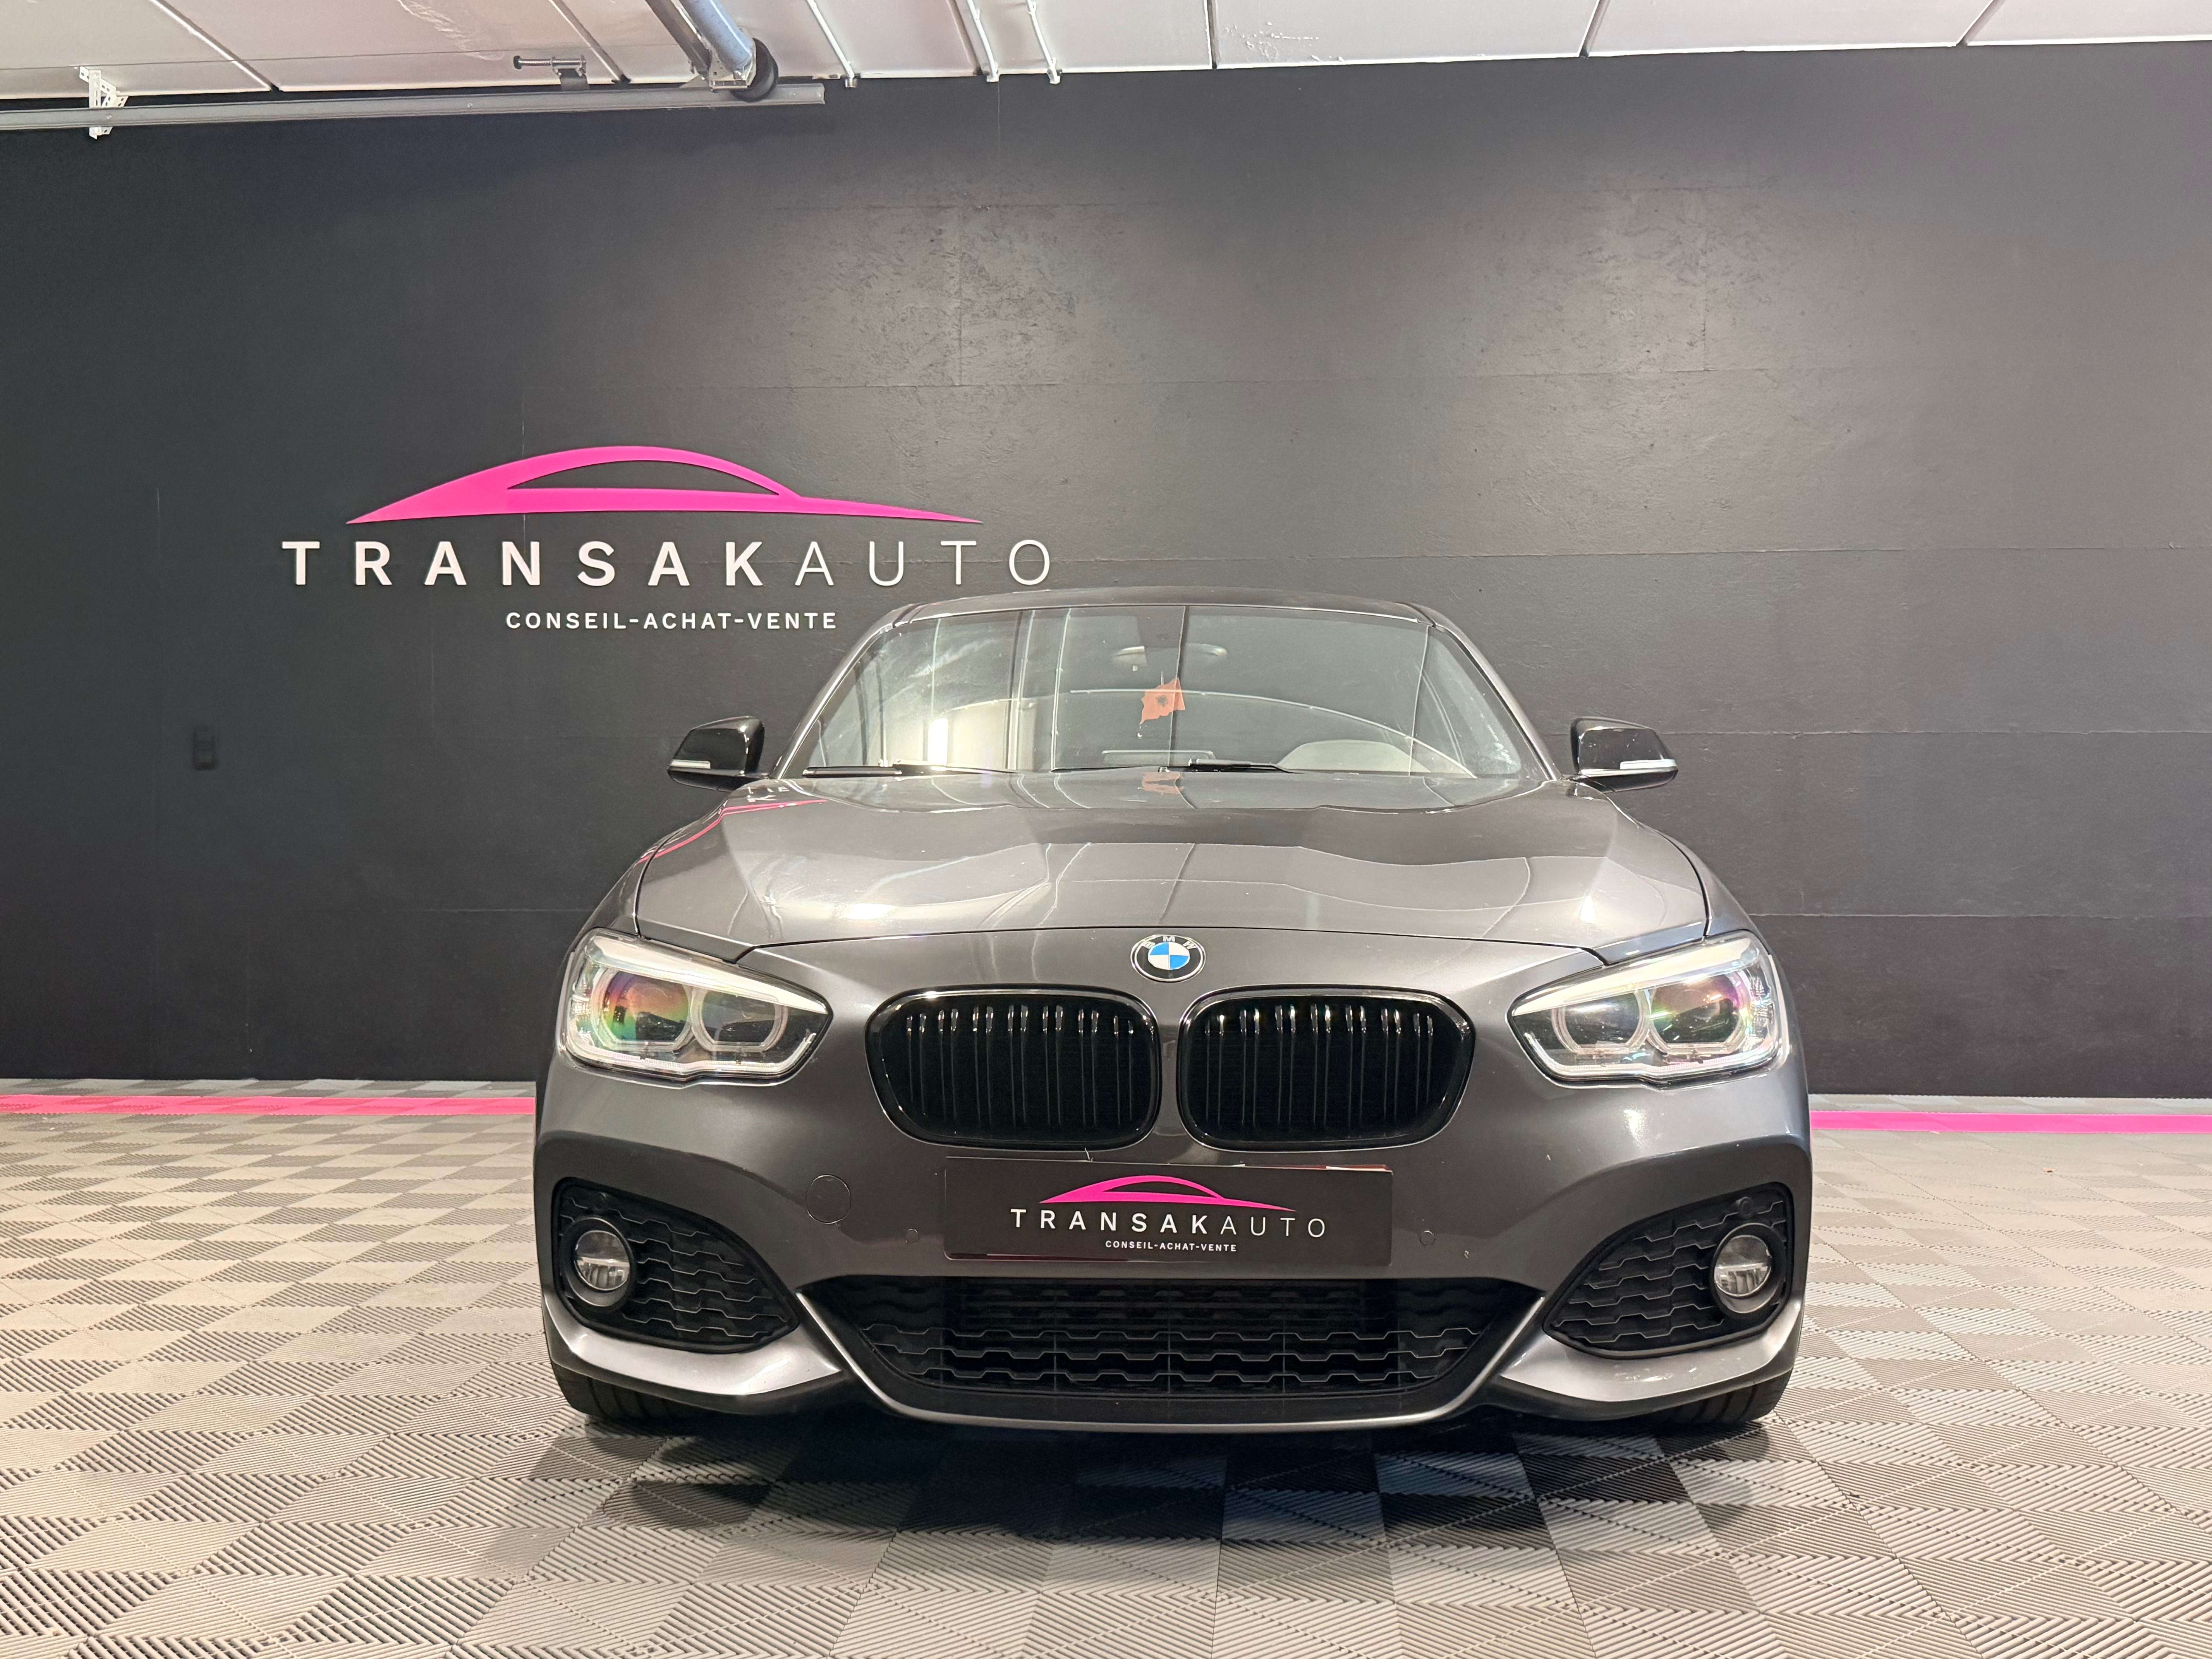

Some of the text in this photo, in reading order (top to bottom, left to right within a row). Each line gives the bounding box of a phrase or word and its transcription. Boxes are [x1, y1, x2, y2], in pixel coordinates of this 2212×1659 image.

[282, 539, 1050, 586] TRANSAKAUTO
[506, 612, 836, 630] CONSEIL-ACHAT-VENTE
[1143, 936, 1197, 950] BMW
[1010, 1208, 1325, 1238] TRANSAKAUTO
[1105, 1240, 1237, 1252] CONSEIL-ACHAT-VENTE
